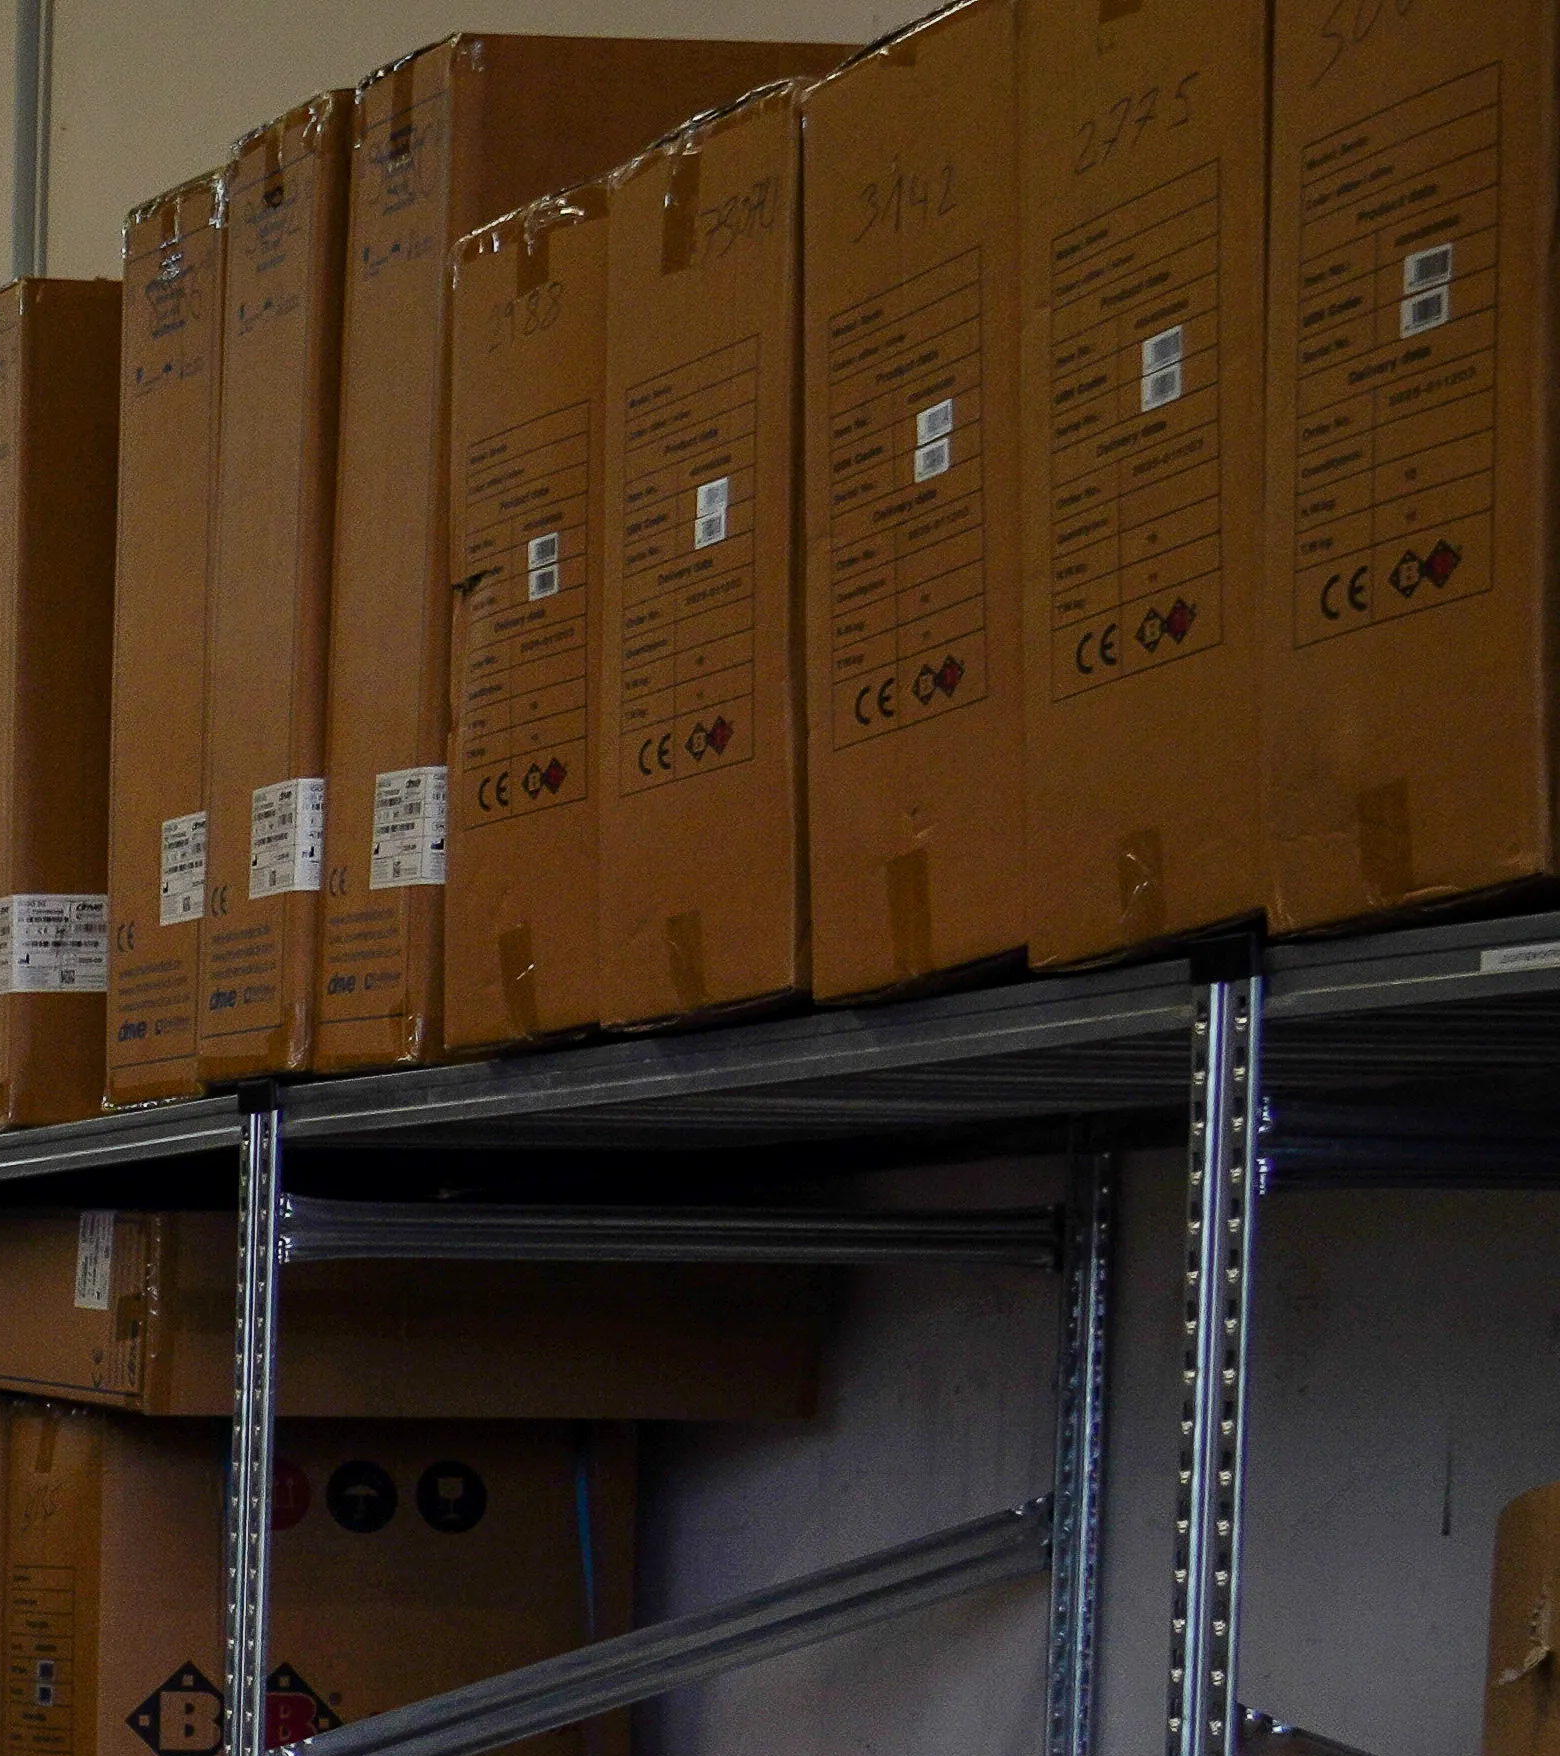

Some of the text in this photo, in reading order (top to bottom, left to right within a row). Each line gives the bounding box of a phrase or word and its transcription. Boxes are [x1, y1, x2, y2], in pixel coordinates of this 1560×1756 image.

[1075, 72, 1199, 174] 2775
[328, 974, 356, 994] drive
[209, 989, 236, 1010] drive
[118, 1020, 147, 1042] drive
